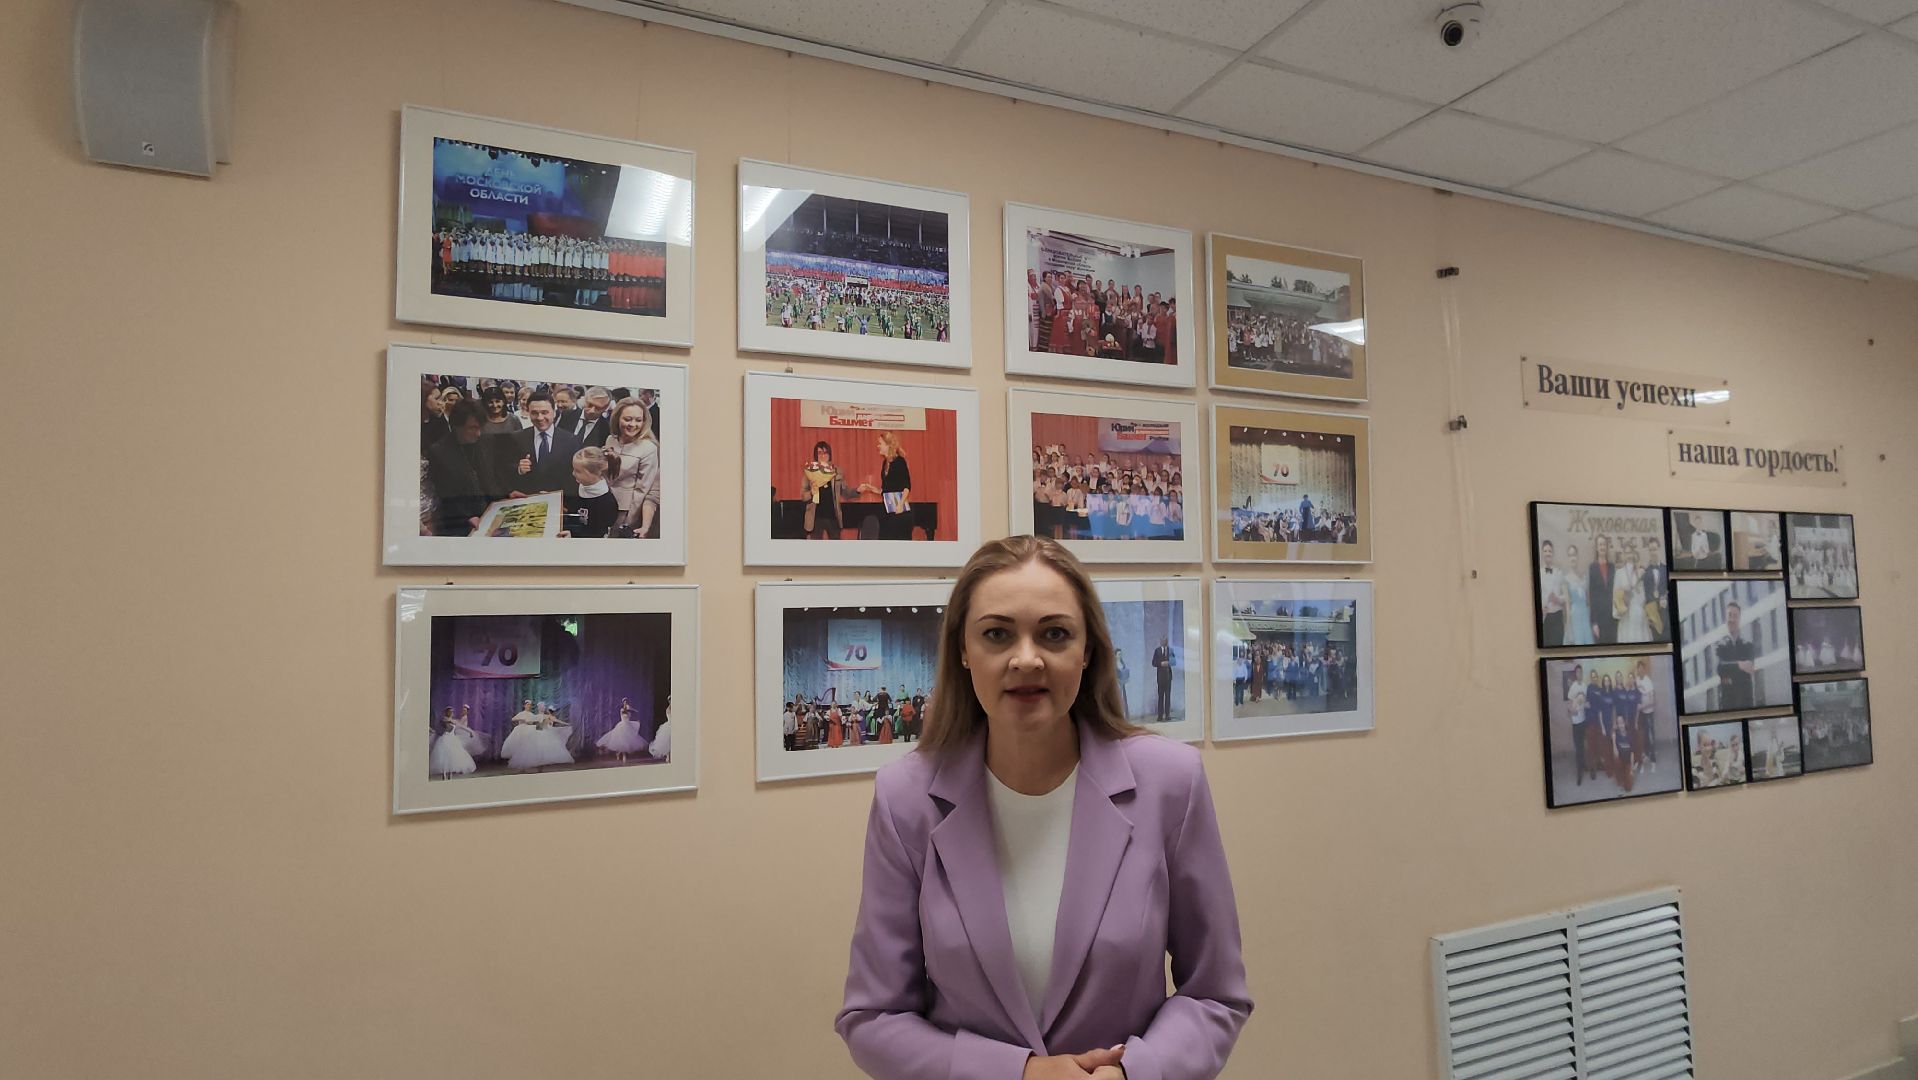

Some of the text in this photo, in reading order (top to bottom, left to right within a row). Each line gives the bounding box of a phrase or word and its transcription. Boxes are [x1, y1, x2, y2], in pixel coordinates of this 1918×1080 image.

[469, 188, 529, 205] ОБЛАСТИ
[1536, 364, 1697, 410] Ваши успехи
[829, 415, 874, 427] Башмет
[1677, 442, 1838, 477] наша гордость!
[1273, 463, 1290, 478] 70
[1567, 509, 1657, 540] Жуковская
[477, 644, 518, 667] 70
[844, 644, 868, 662] 70
